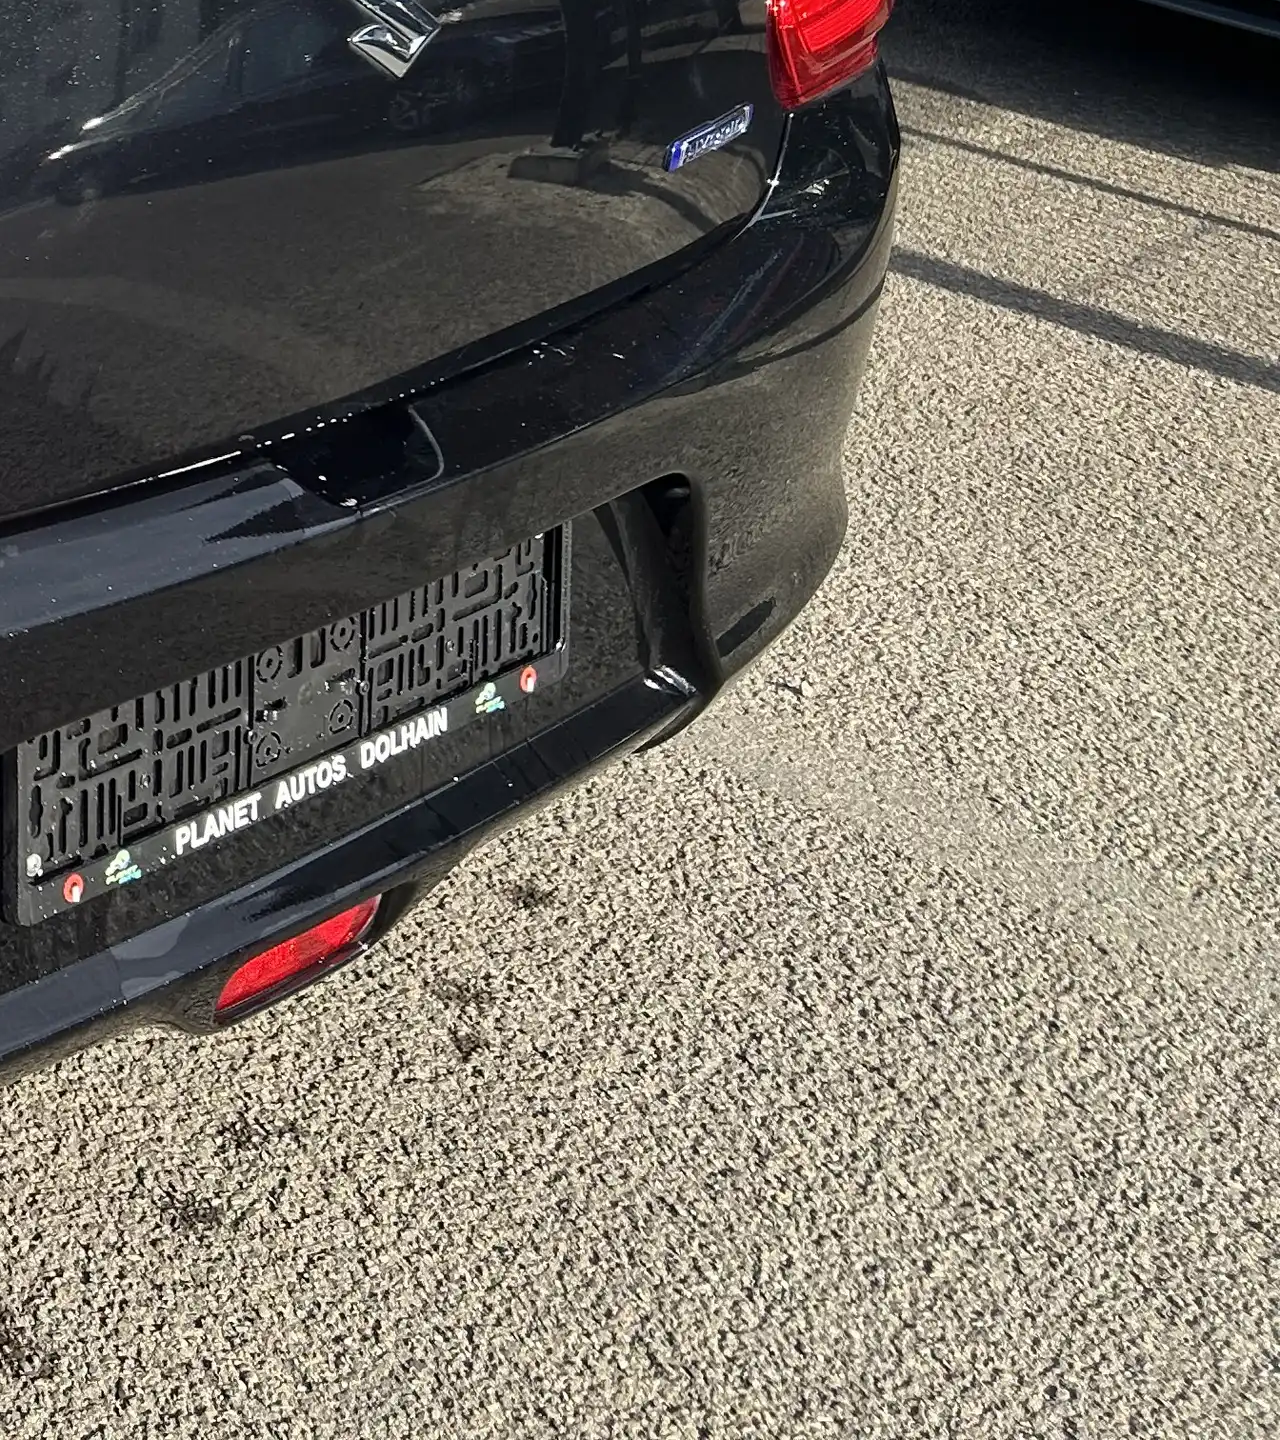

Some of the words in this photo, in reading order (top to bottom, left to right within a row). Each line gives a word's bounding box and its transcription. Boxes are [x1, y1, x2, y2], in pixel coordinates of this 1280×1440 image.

[174, 792, 262, 856] PLANET
[274, 753, 348, 811] AUTOS
[359, 707, 449, 771] DOLHAIN
